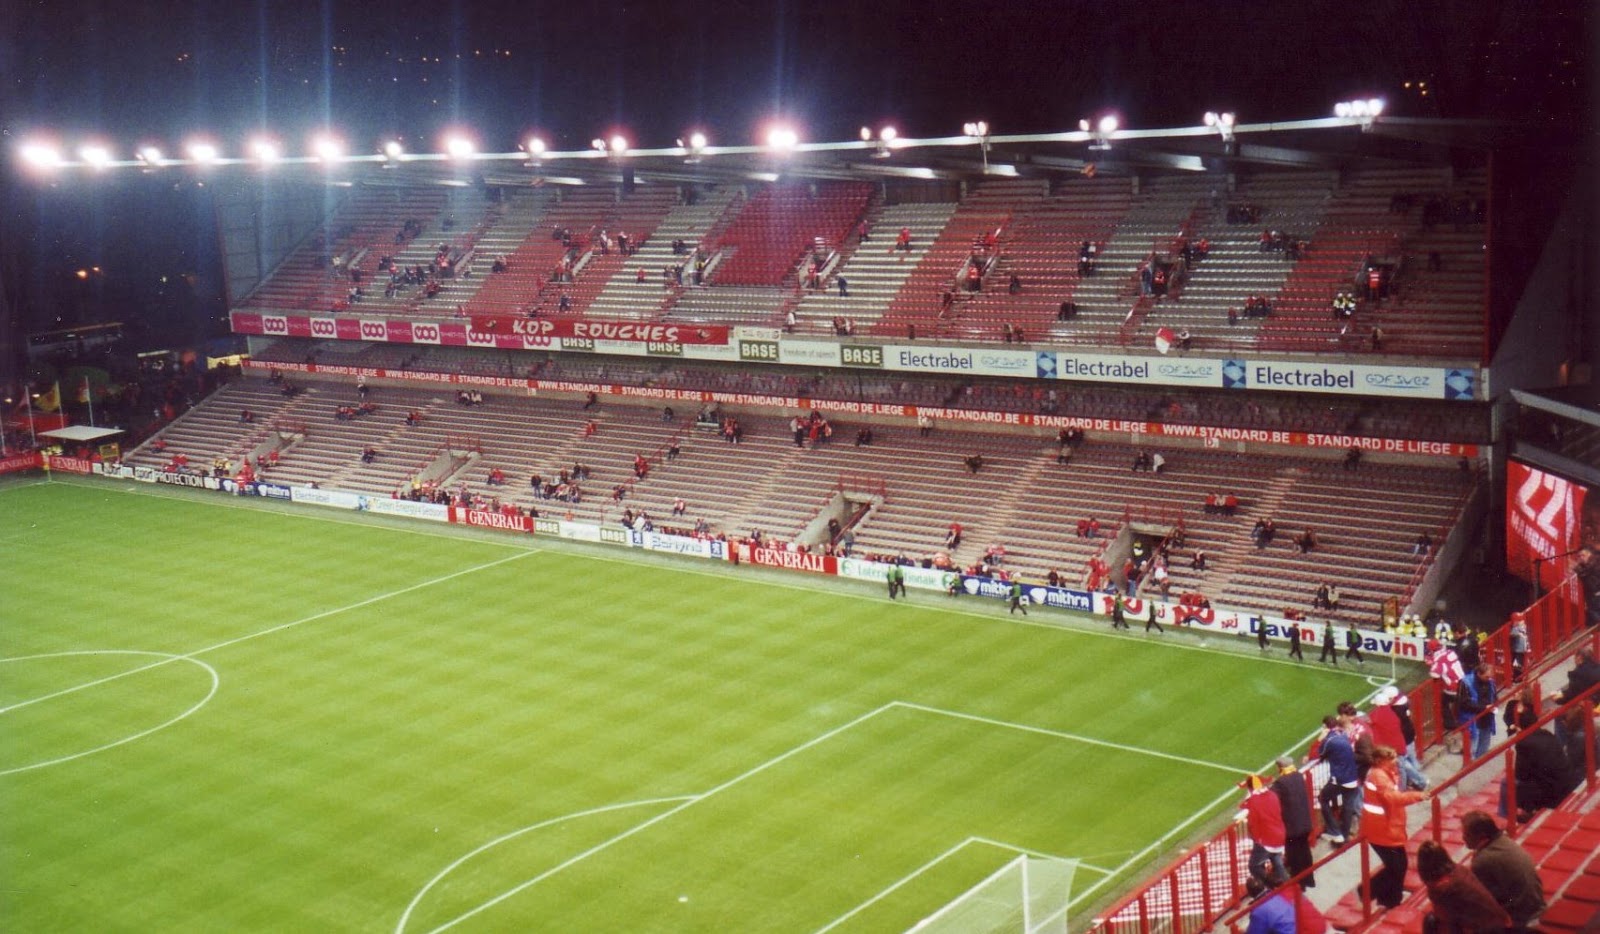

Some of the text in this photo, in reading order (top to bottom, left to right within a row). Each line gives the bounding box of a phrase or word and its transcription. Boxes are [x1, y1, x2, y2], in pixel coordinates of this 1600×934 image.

[513, 319, 679, 341] KOP ROUCHES
[741, 342, 777, 359] BASE
[843, 348, 881, 364] BASE
[899, 351, 973, 369] Electrabel
[1065, 359, 1149, 378] Electrabel
[315, 364, 378, 377] STANDARD DE LIEGE
[385, 370, 451, 382] WWW.STANDARD.BE
[1255, 366, 1354, 388] Electrabel
[458, 375, 529, 388] STANDARD DE LIEGE
[537, 380, 613, 394] WWW.STANDARD.BE
[622, 386, 703, 401] STANDARD DE LIEGE
[712, 392, 799, 408] WWW.STANDARD.BE
[810, 399, 904, 416] STANDARD DE LIEGE
[916, 407, 1020, 423] WWW.STANDARD.BE
[1033, 414, 1148, 434] STANDARD DE LIEGE
[1162, 424, 1291, 442] WWW.STANDARD.BE
[1307, 433, 1451, 455] STANDARD DE LIEGE
[155, 470, 203, 487] PROTECTION
[469, 510, 527, 531] GENERALI
[754, 547, 825, 573] GENERALI
[981, 580, 1014, 596] mithr
[1048, 589, 1090, 608] mithra
